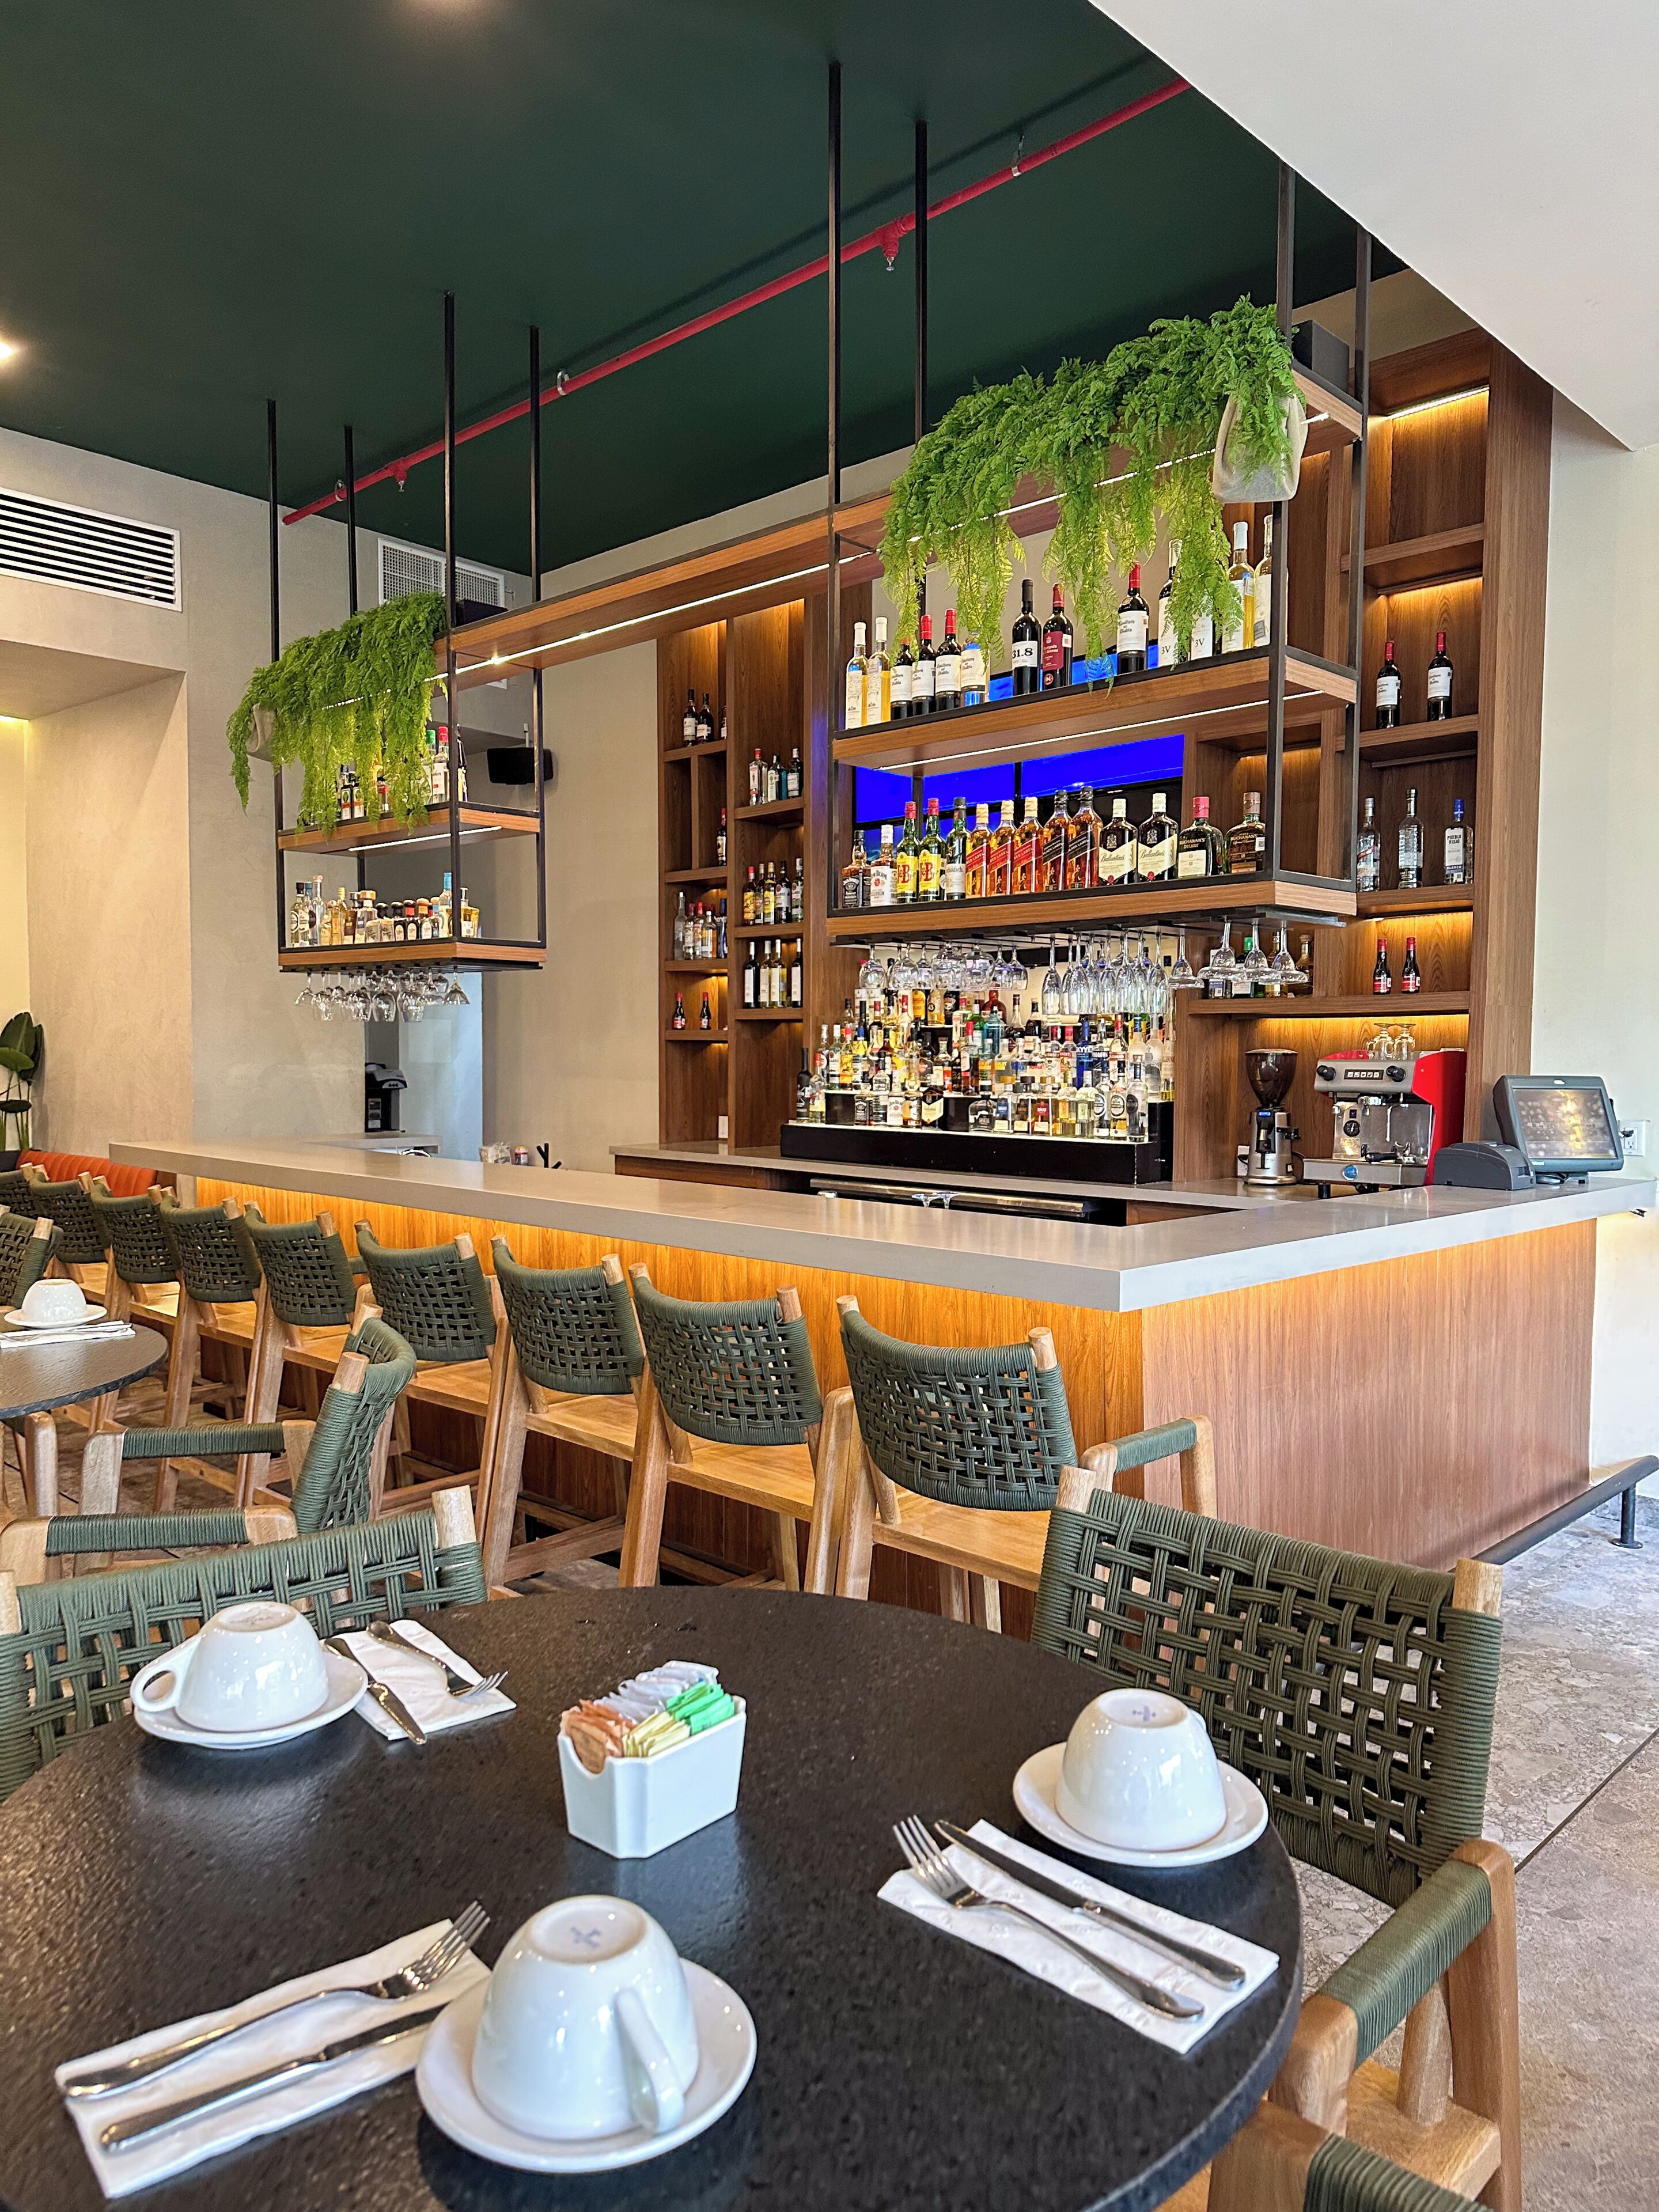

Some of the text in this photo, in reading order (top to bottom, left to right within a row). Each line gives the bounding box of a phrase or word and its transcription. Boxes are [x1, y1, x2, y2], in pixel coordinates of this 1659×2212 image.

[1194, 638, 1205, 648] 3V
[1012, 647, 1033, 659] 31.8
[1161, 645, 1171, 655] 3V
[1021, 847, 1033, 857] LABEL
